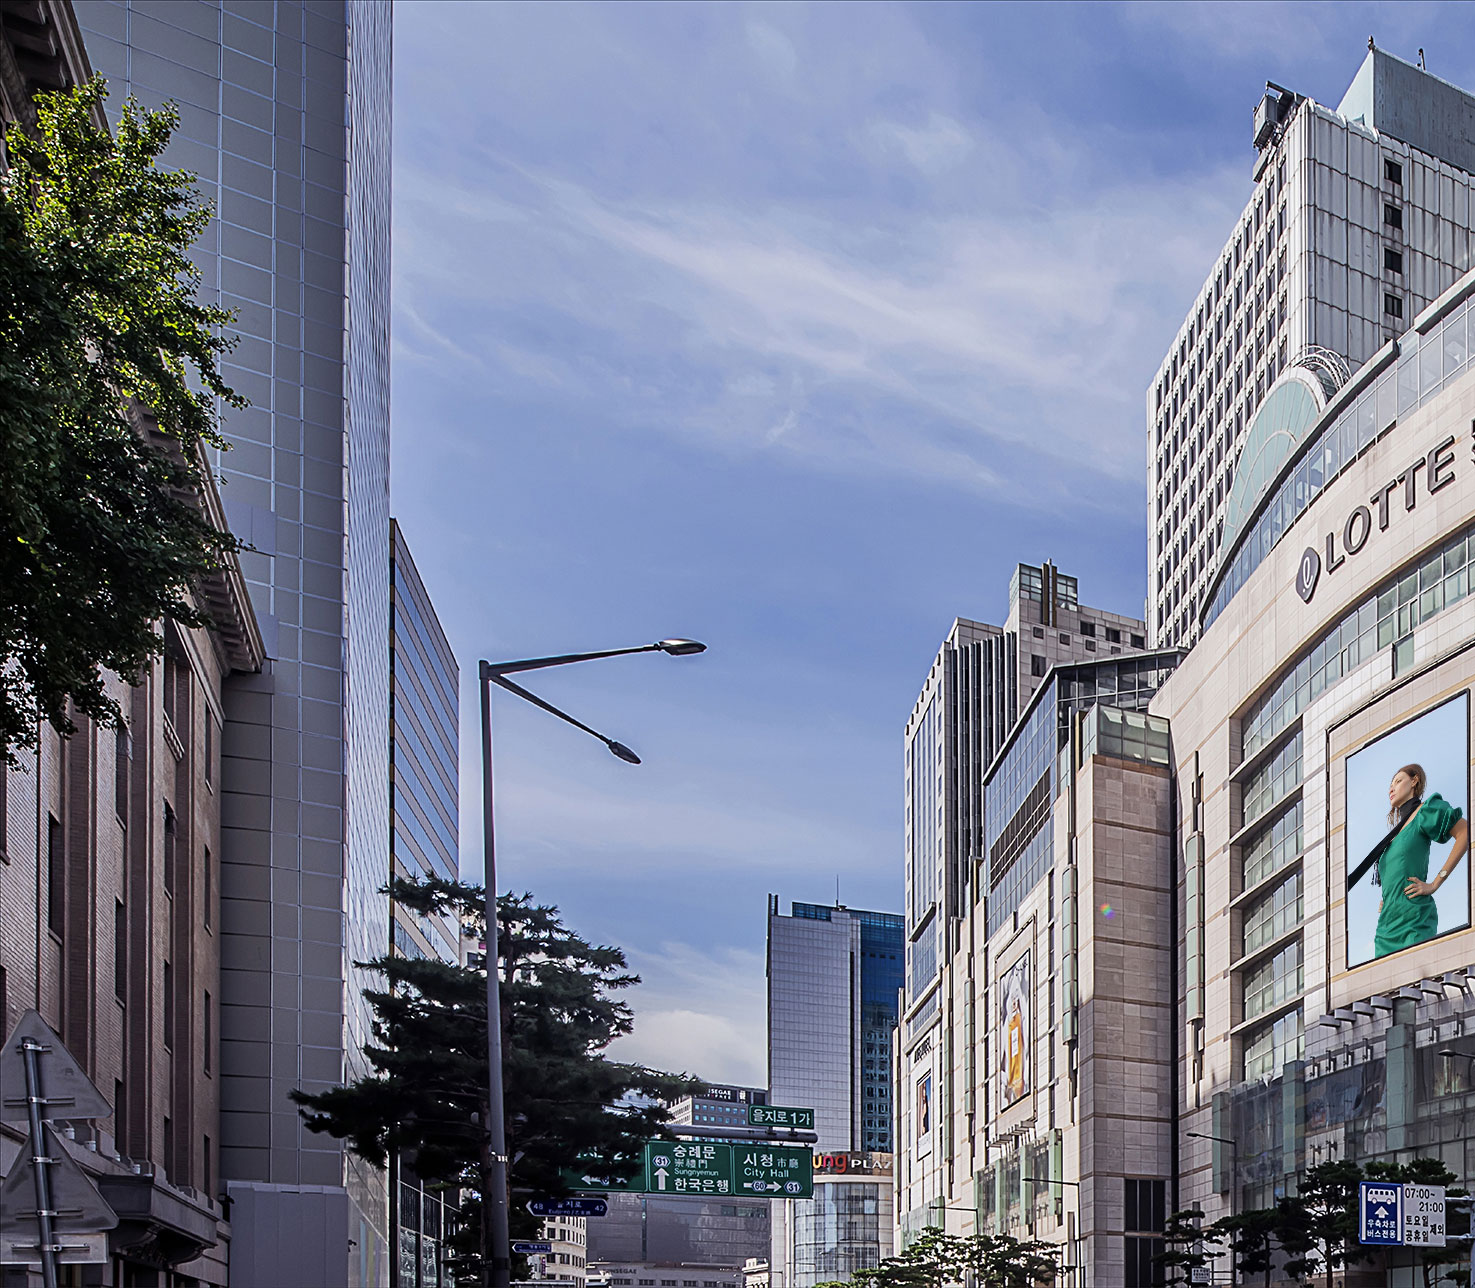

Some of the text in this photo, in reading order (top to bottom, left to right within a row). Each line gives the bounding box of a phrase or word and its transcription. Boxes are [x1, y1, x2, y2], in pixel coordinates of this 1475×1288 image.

[1326, 435, 1456, 574] LOTTE
[673, 1145, 716, 1159] 숭례문
[743, 1152, 774, 1168] 시청
[813, 1155, 892, 1173] ung PLAZ
[674, 1168, 719, 1177] Sungnyemun
[744, 1167, 789, 1179] City Hall
[674, 1178, 729, 1193] 한국은행
[1419, 1202, 1443, 1212] 21:00
[1367, 1219, 1396, 1229] 우측차로
[1405, 1215, 1429, 1227] 토요일
[1367, 1229, 1396, 1239] 버스전용
[1430, 1224, 1444, 1235] 제외
[1405, 1230, 1429, 1242] 공휴일
